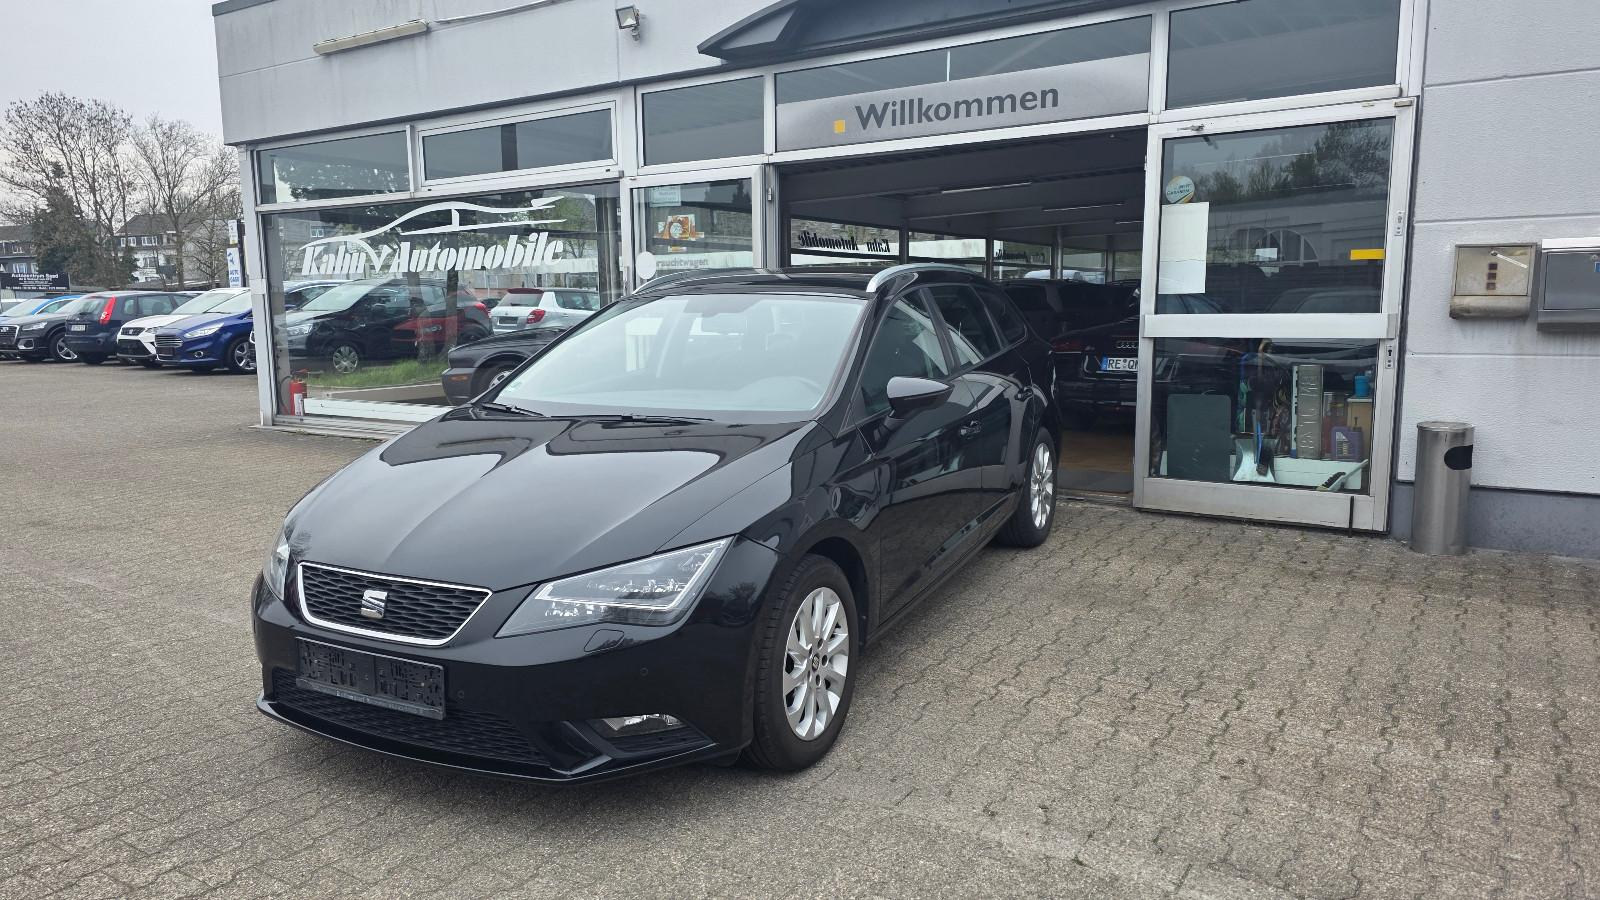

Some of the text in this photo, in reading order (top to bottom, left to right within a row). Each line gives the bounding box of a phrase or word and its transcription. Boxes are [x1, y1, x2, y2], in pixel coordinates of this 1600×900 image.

[855, 88, 1059, 131] Willkommen
[389, 232, 564, 274] Automobile
[656, 257, 708, 268] rauchtwagen
[1108, 359, 1121, 369] RE
